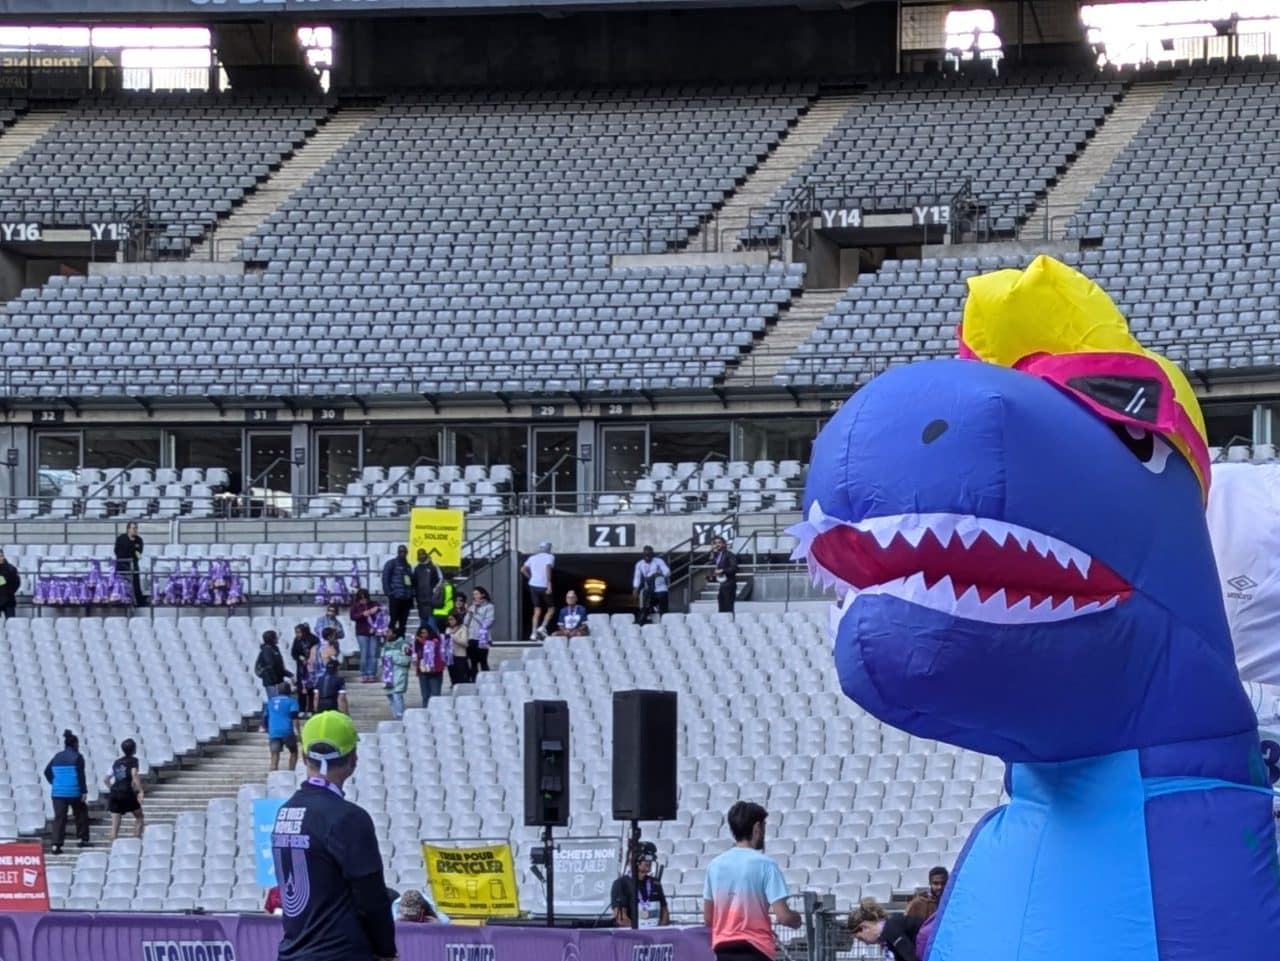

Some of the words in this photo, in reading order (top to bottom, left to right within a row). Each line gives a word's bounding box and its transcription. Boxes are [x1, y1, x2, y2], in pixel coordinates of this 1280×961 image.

[823, 209, 861, 227] Y14
[914, 205, 950, 225] Y13
[1, 223, 40, 241] Y16
[92, 223, 130, 240] Y15
[320, 409, 336, 419] 30
[540, 406, 555, 415] 29
[608, 404, 623, 414] 28
[41, 411, 55, 421] 32
[253, 410, 268, 420] 31
[595, 526, 627, 546] Z1
[464, 851, 494, 861] POUR
[594, 848, 615, 858] NON
[15, 855, 41, 866] MON
[436, 859, 504, 874] RECYCLER
